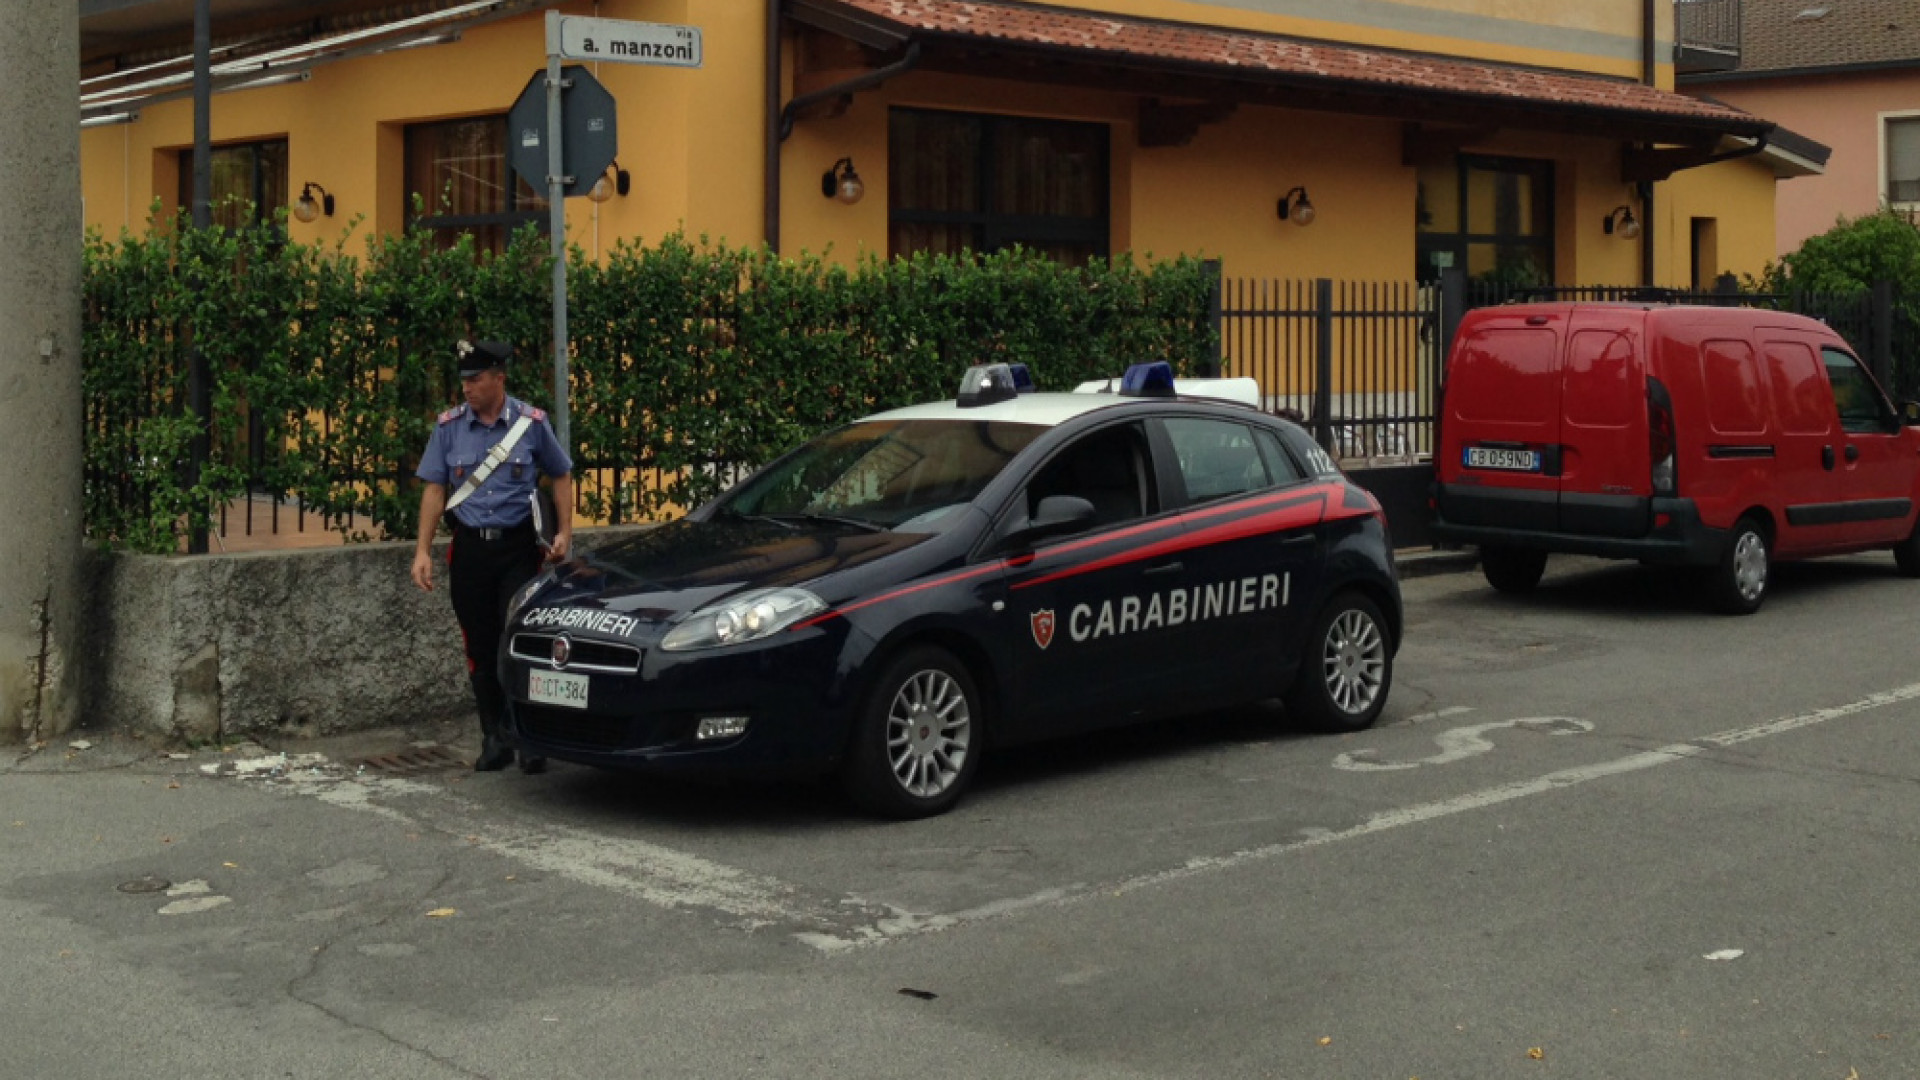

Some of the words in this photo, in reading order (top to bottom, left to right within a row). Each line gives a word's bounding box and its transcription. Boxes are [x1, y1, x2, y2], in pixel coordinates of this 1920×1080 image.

[676, 29, 692, 39] via
[583, 37, 600, 53] a.
[610, 40, 693, 60] manzoni
[1470, 450, 1486, 465] CB
[1069, 571, 1291, 642] CARABINIERI
[522, 607, 639, 637] CARABINIERI
